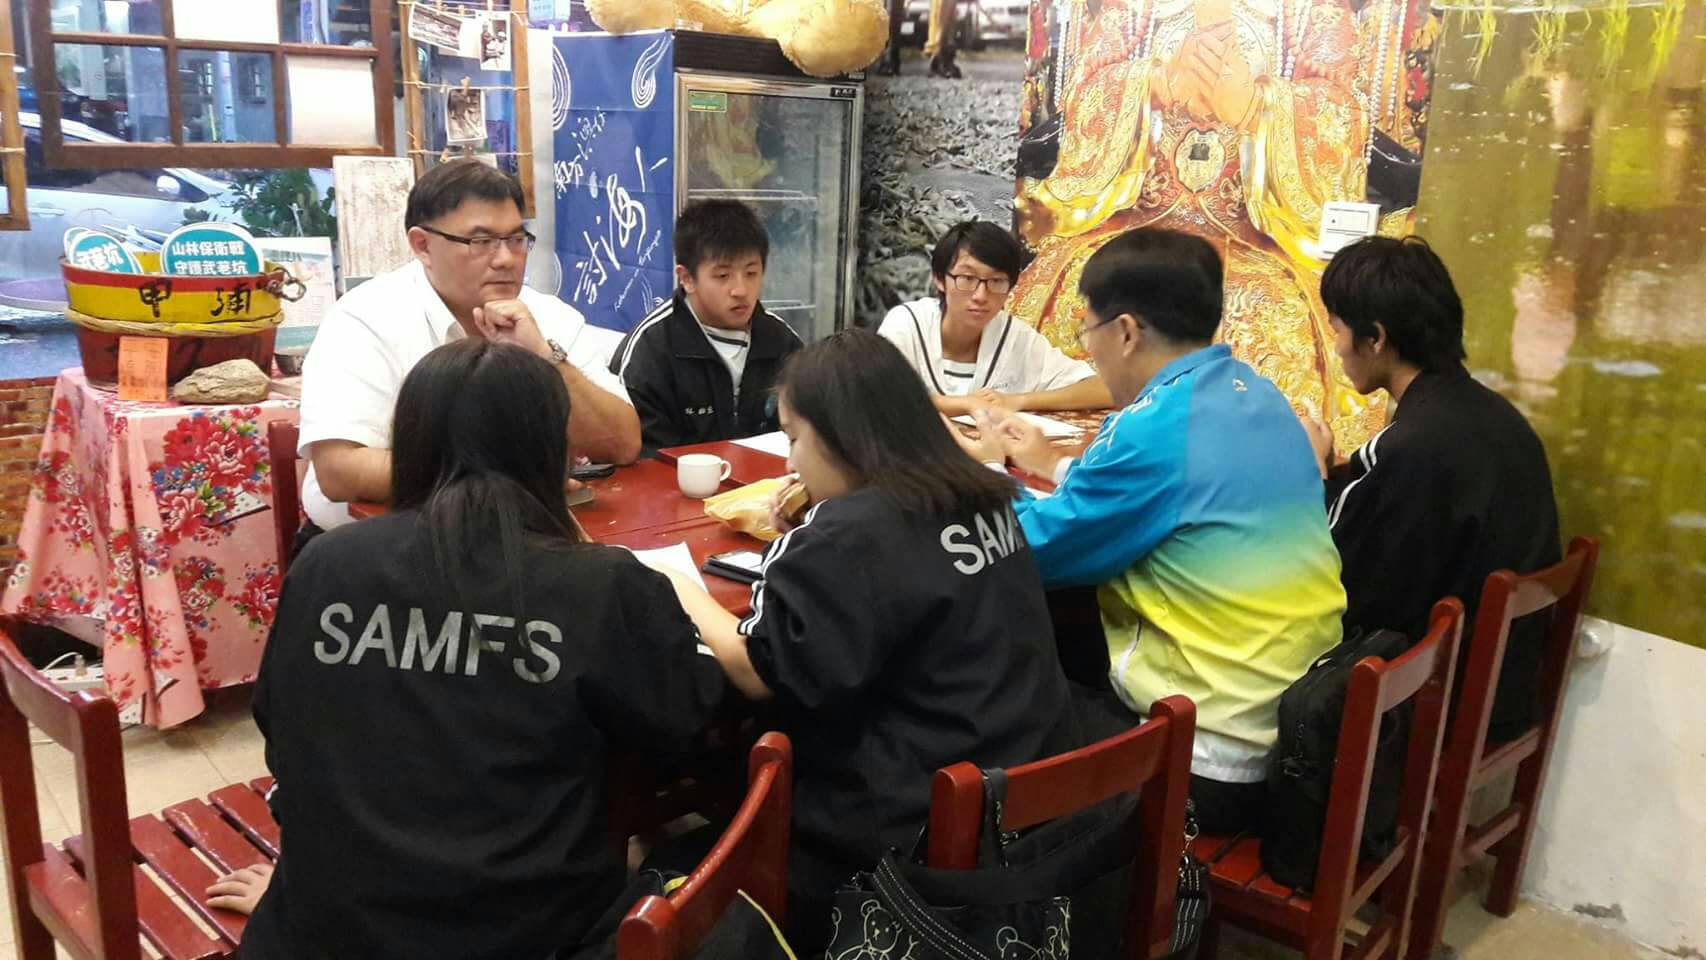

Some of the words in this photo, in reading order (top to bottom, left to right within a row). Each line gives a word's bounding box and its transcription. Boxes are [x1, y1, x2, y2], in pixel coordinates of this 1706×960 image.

[172, 240, 245, 256] 山林保衛戰
[313, 602, 563, 684] SAMFS
